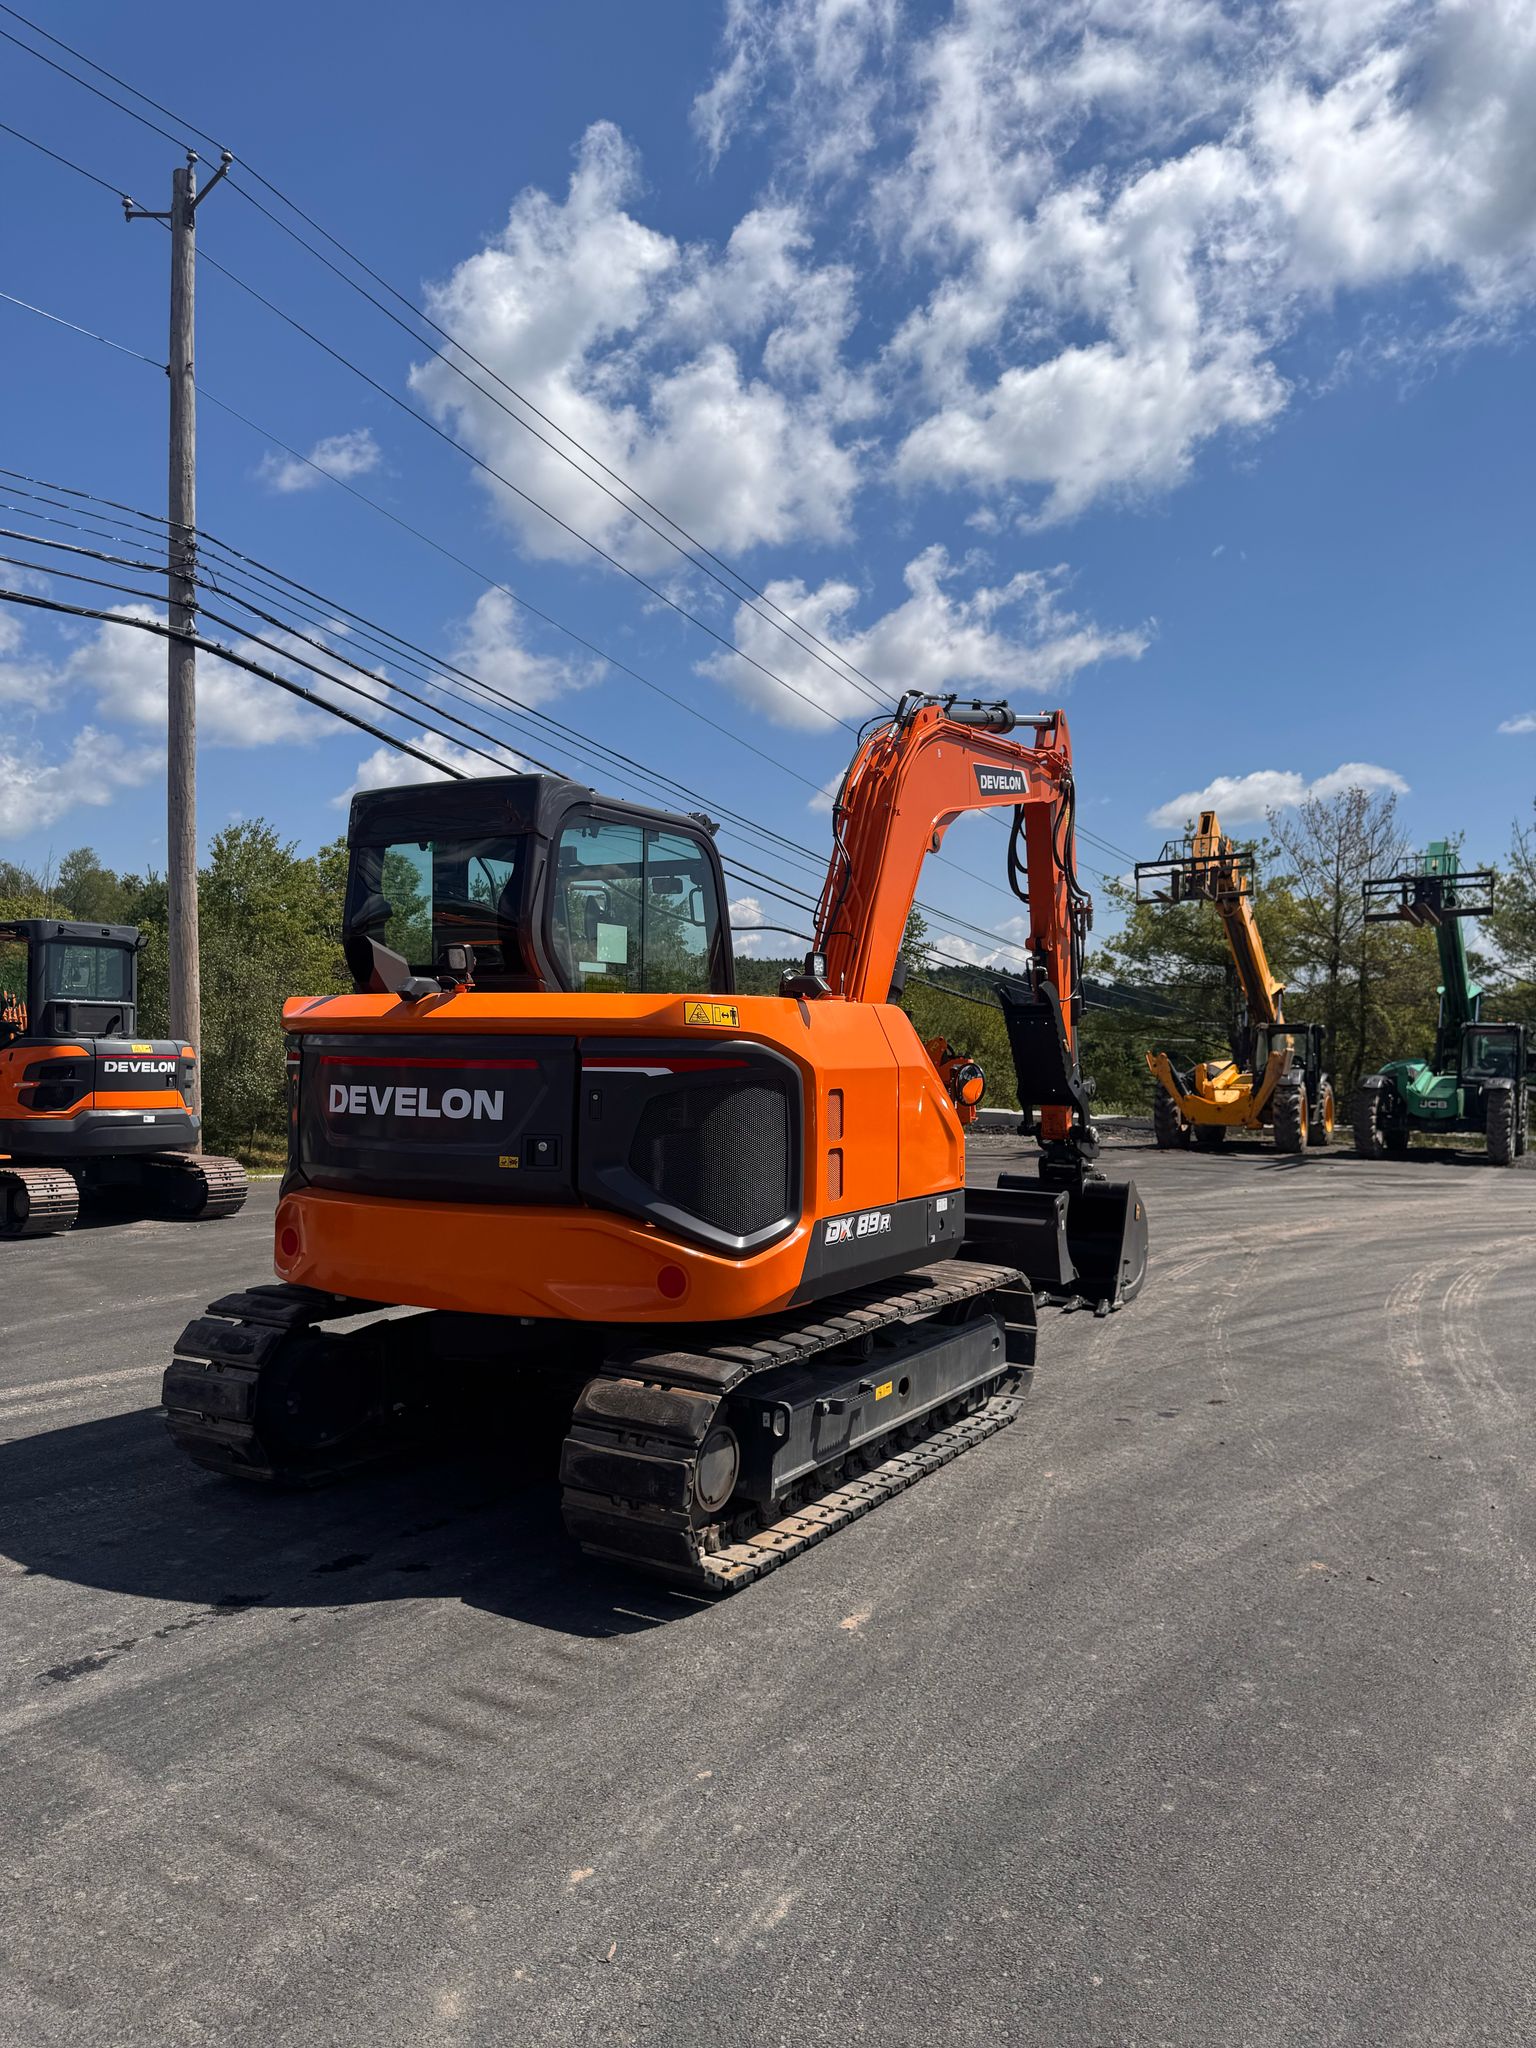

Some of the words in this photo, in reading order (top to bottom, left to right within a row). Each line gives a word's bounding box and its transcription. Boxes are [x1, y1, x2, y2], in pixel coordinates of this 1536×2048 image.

[980, 774, 1021, 790] DEVELON
[104, 1061, 175, 1073] DEVELON
[329, 1084, 504, 1121] DEVELON
[1420, 1100, 1448, 1110] JCB
[825, 1216, 855, 1245] DX
